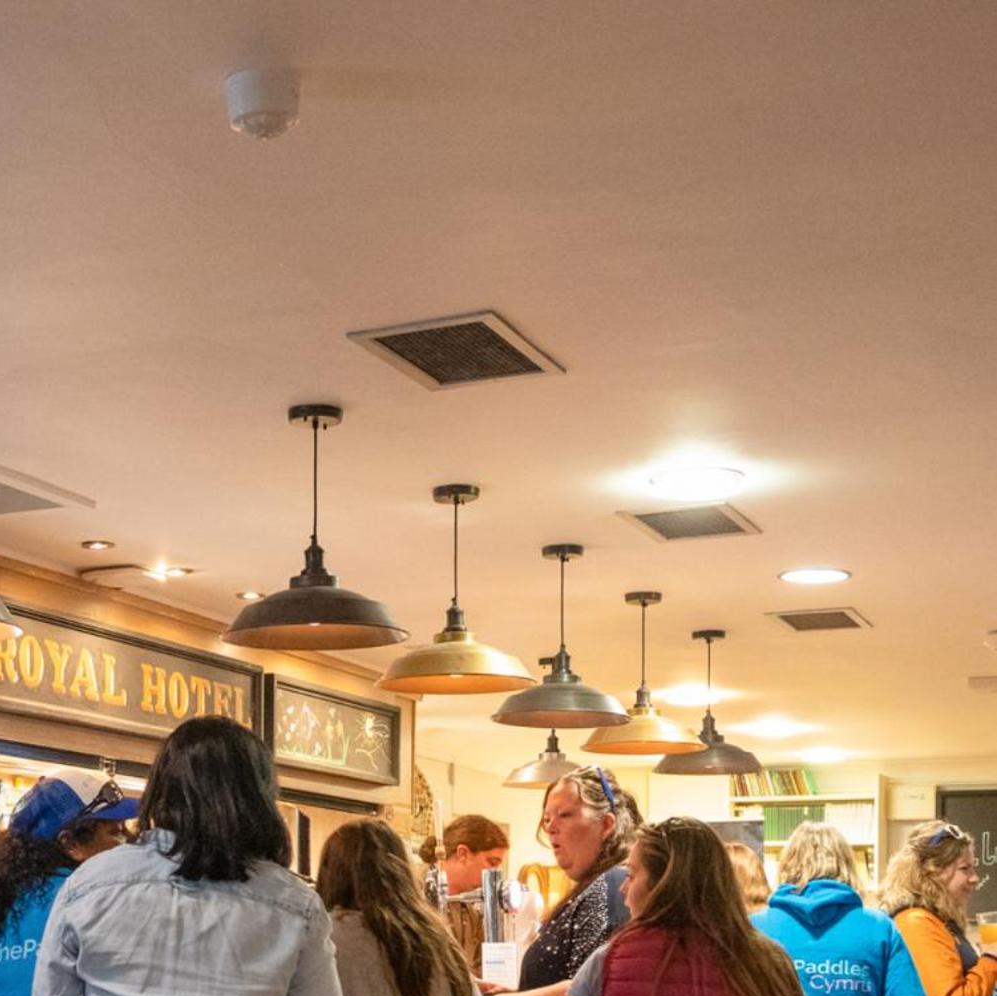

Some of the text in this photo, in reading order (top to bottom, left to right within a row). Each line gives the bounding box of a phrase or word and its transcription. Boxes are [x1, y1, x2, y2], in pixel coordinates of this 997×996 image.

[141, 663, 252, 728] HOTEL
[793, 959, 870, 977] Paddles
[809, 974, 872, 995] Cymru
